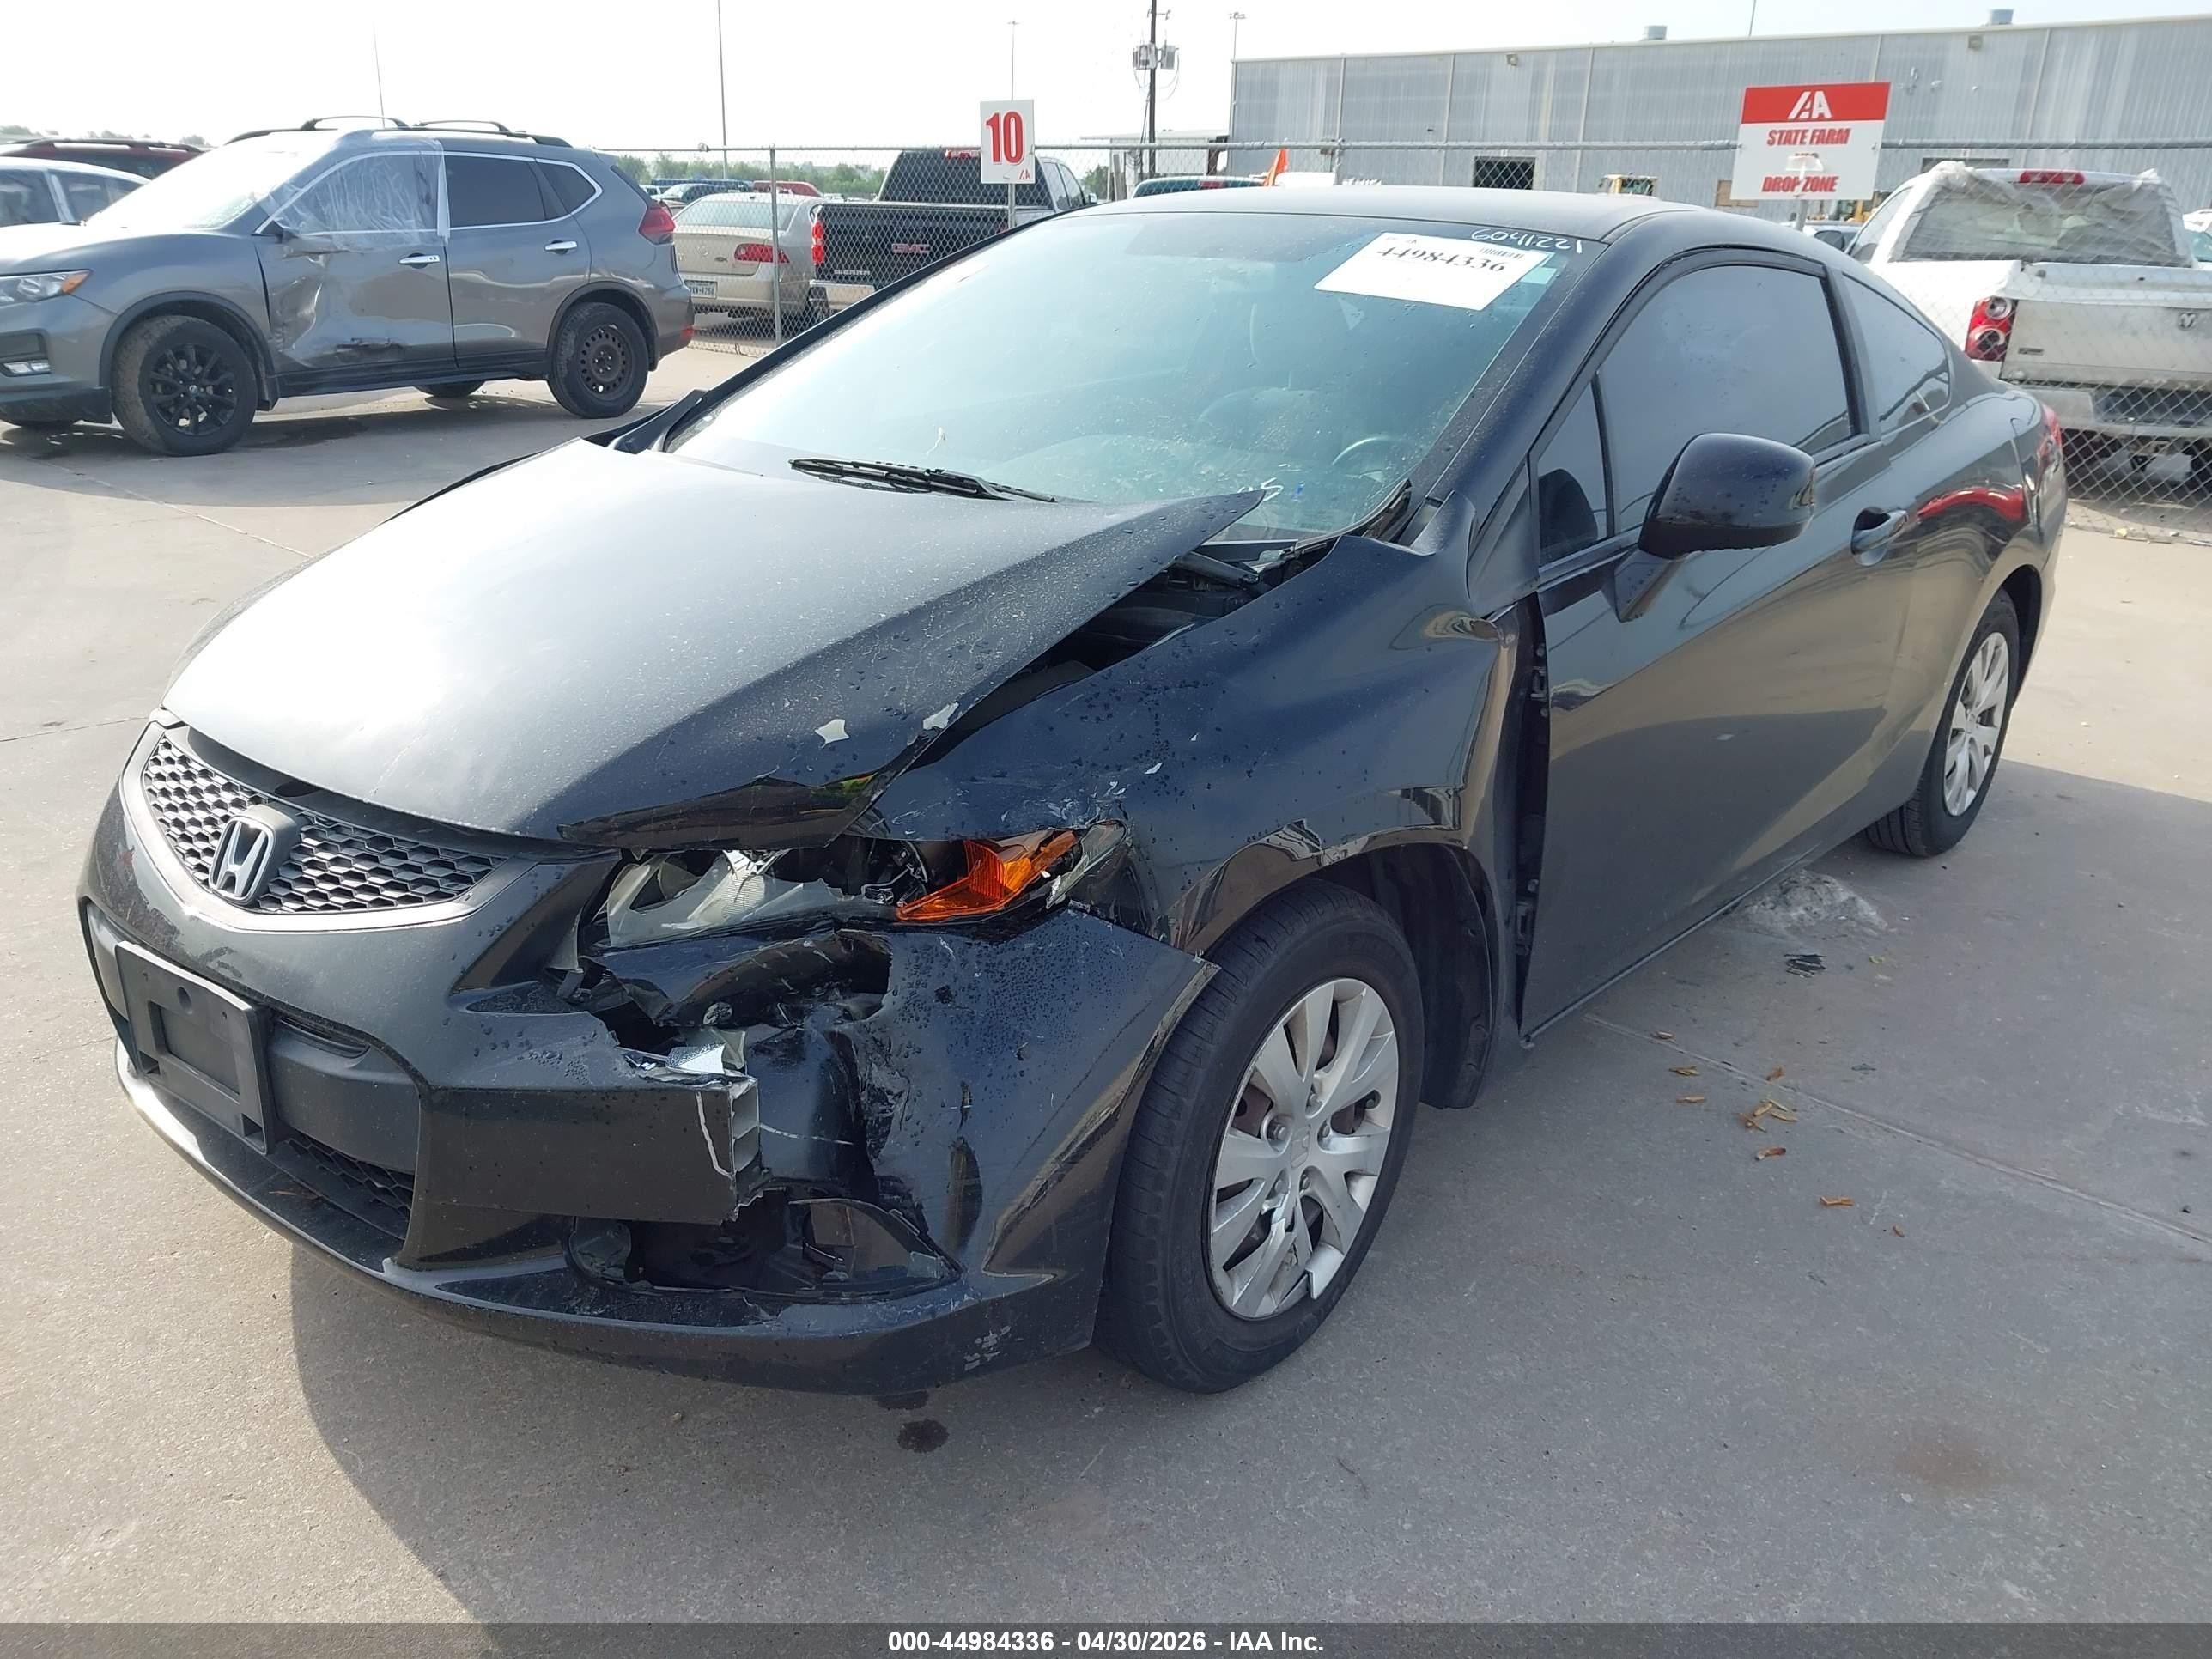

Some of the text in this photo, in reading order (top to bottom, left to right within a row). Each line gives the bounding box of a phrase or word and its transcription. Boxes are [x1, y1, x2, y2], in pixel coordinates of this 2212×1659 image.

[986, 111, 1024, 163] 10
[1766, 128, 1851, 146] STATE FARM
[1762, 176, 1839, 192] DROP ZONE
[892, 243, 930, 254] GMC
[1471, 228, 1583, 253] 6041221
[1376, 247, 1507, 272] 44984336
